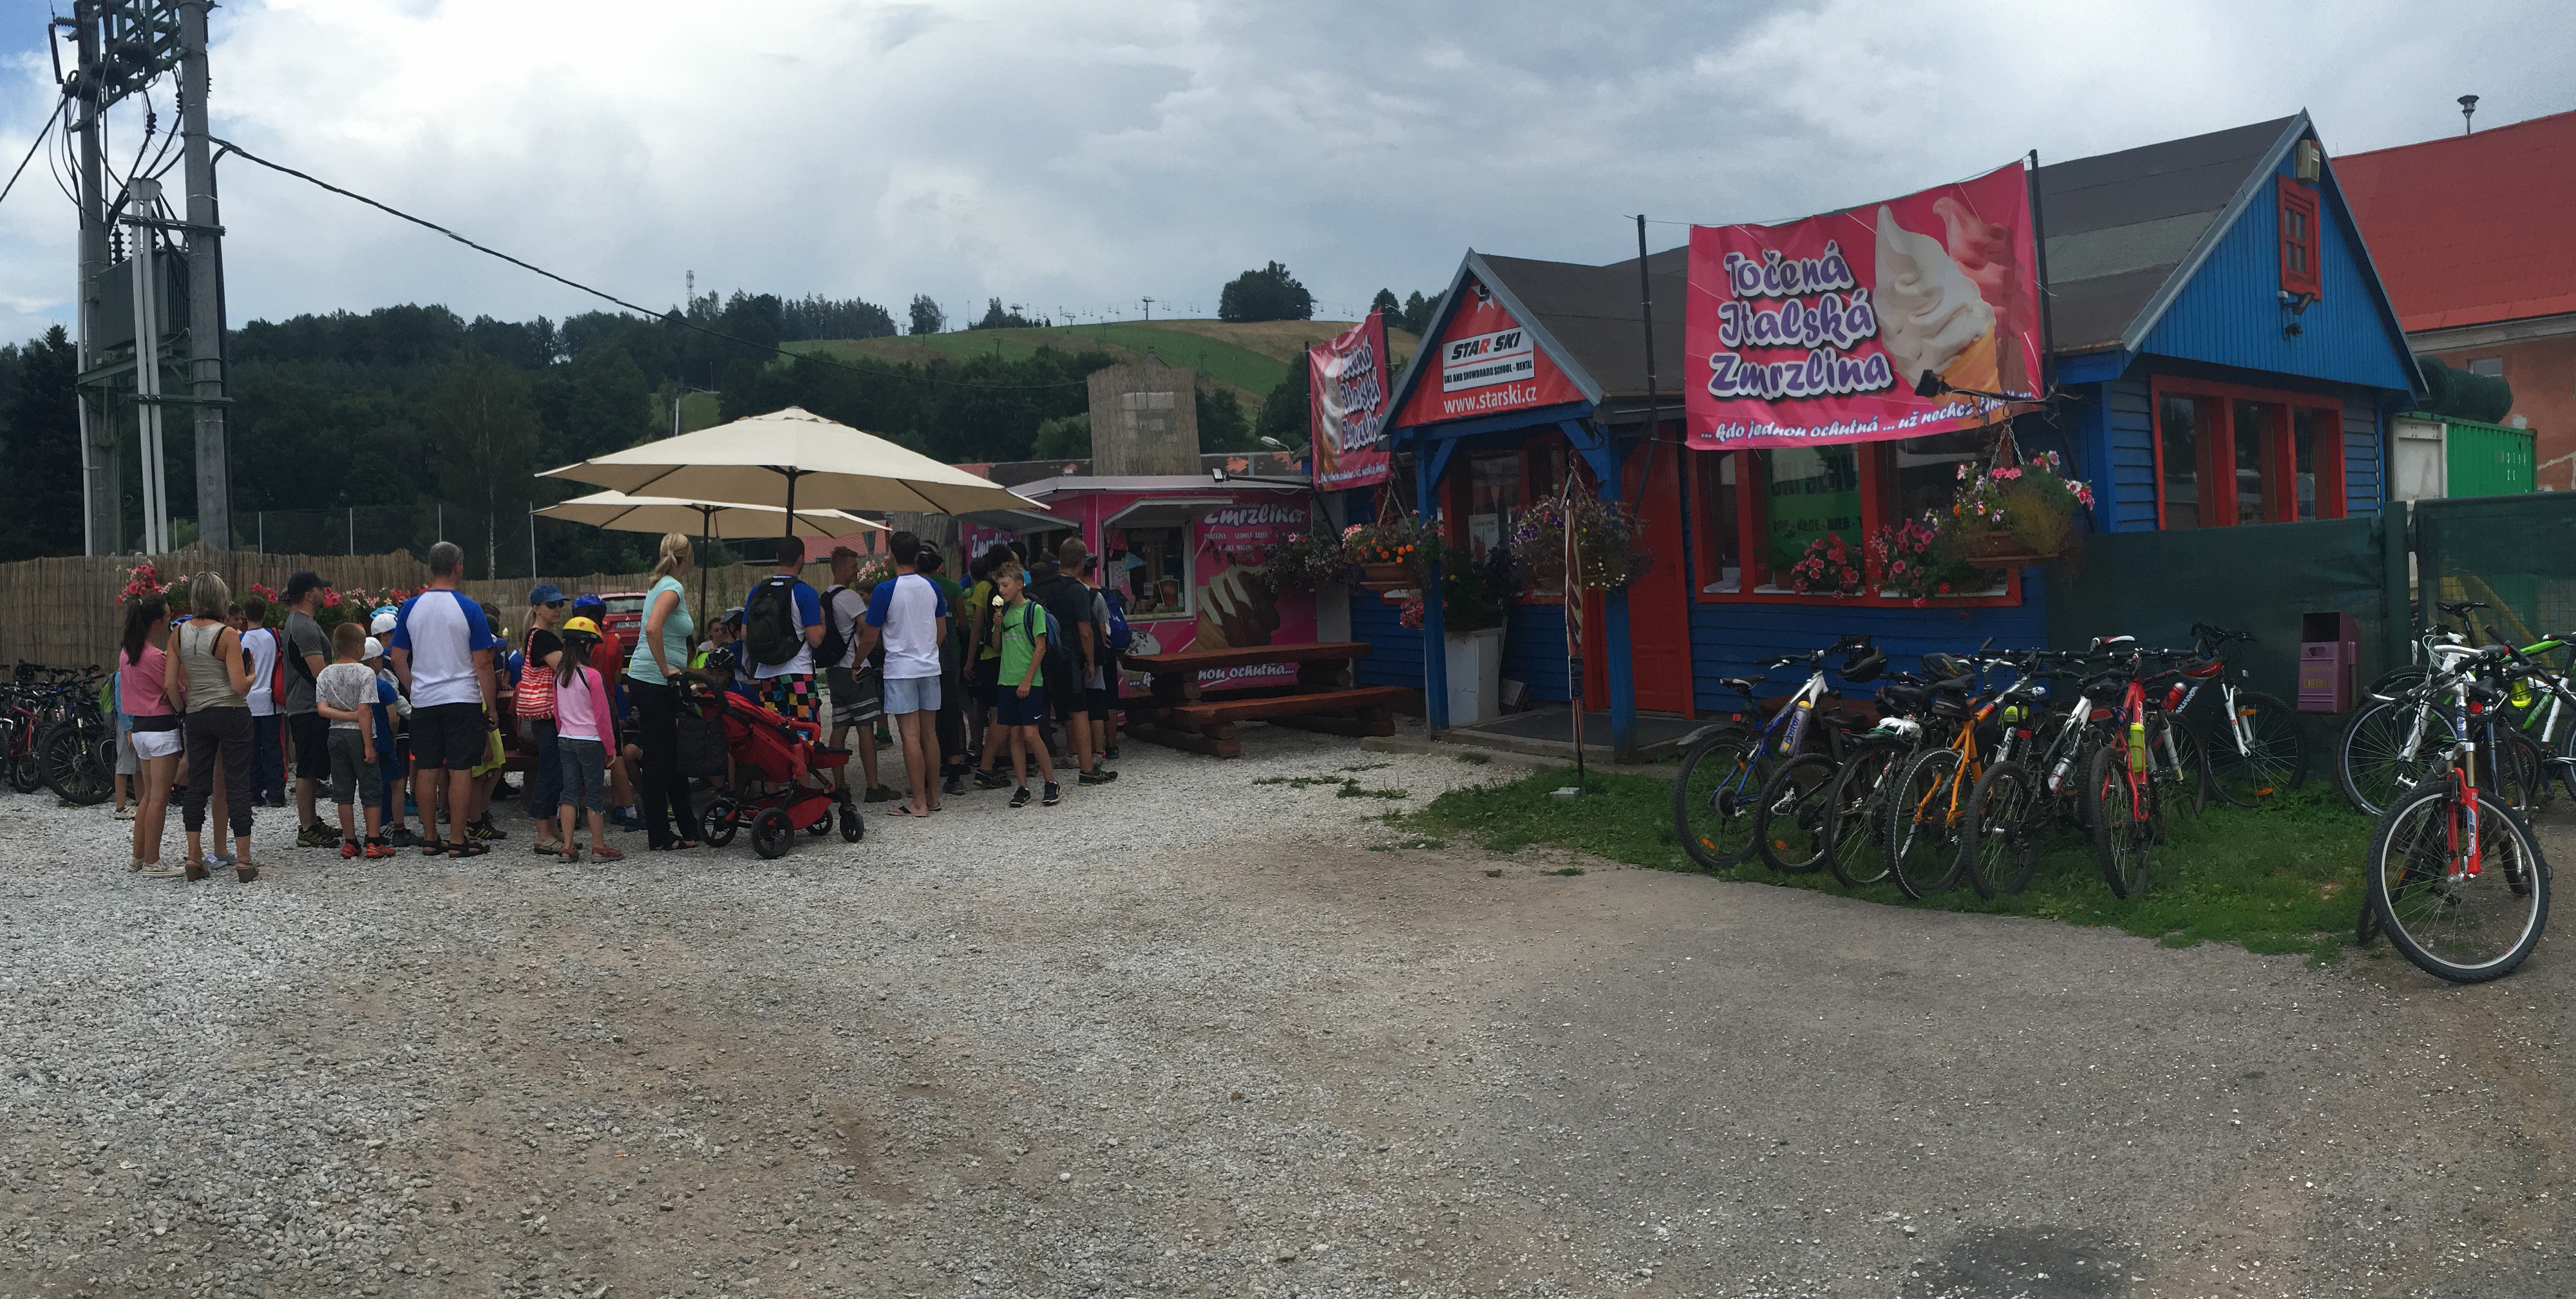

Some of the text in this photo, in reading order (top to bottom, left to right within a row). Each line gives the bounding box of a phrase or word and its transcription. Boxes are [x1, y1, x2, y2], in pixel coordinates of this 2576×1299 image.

[1724, 239, 1855, 298] Točená
[1452, 332, 1520, 360] STAR SKI
[1444, 360, 1533, 384] SKI AND SNOWBOARD SCHOOL RENTAL
[1709, 348, 1893, 399] Zmrzlina
[1443, 384, 1537, 413] www.starski.cz
[1343, 410, 1386, 450] Zmrzlin
[1716, 422, 1745, 442] kdo
[1748, 421, 1806, 439] jednou
[1810, 415, 1878, 437] ochutná
[1897, 411, 1919, 429] už
